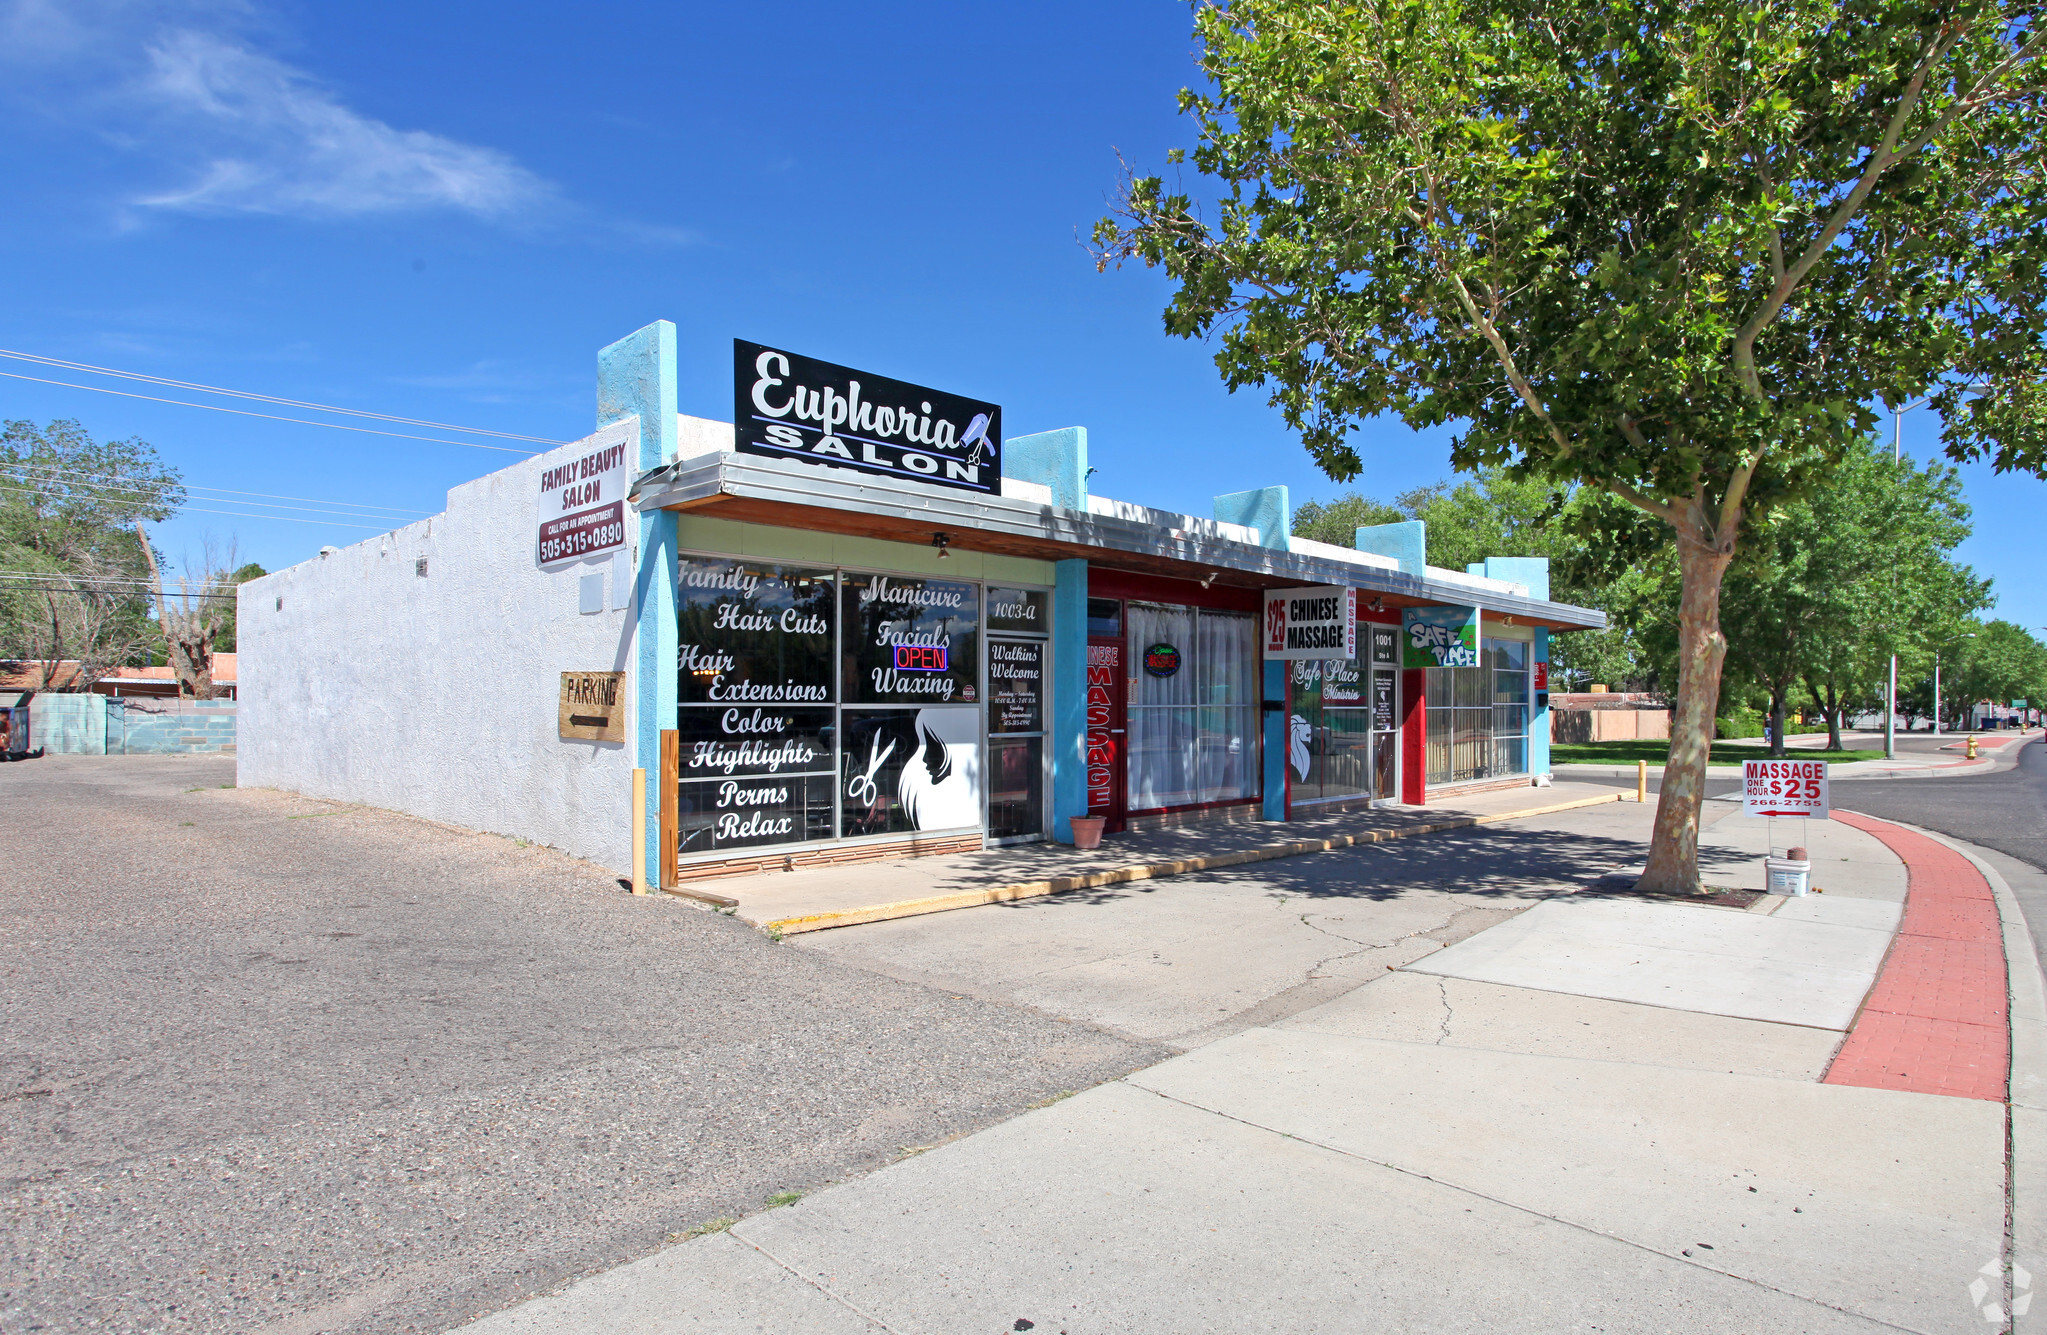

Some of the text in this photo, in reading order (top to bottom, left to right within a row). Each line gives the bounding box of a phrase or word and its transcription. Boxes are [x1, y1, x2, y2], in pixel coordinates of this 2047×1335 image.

[752, 351, 960, 449] Euphoria
[541, 442, 626, 492] FAMILY BEAUTY
[765, 425, 979, 483] SALON
[562, 480, 600, 510] SALON
[548, 508, 614, 535] CALL FOR AN APPOINTMENT
[861, 576, 961, 608] Manicure
[714, 604, 827, 635] Hair Cuts
[1268, 599, 1285, 643] $25
[1290, 598, 1338, 622] CHINESE
[1347, 590, 1355, 654] MASSAGE
[1408, 611, 1416, 620] A
[875, 621, 950, 649] Facials
[1287, 625, 1343, 649] MASSAGE
[1375, 634, 1392, 646] 1001
[1409, 623, 1463, 648] SAFE
[677, 644, 735, 671] Hair
[896, 647, 945, 669] OPEN
[991, 645, 1037, 662] Walkins
[1087, 646, 1119, 667] INESE
[1431, 645, 1475, 666] PLACE
[991, 663, 1039, 679] Welcome
[1324, 659, 1359, 682] Place
[567, 678, 617, 706] PARKING
[709, 675, 827, 701] Extensions
[871, 667, 955, 701] Waxing
[997, 690, 1014, 698] Monday
[1018, 690, 1036, 698] Saturday
[1323, 684, 1360, 699] Ministries
[722, 708, 785, 734] Color
[1087, 666, 1113, 808] MASSAGE
[689, 739, 814, 774] Highlights
[1746, 763, 1823, 780] MASSAGE
[1747, 779, 1764, 787] ONE
[716, 781, 788, 808] Perms
[1747, 788, 1768, 796] HOUR
[1770, 779, 1821, 799] $25
[716, 811, 792, 840] Relax
